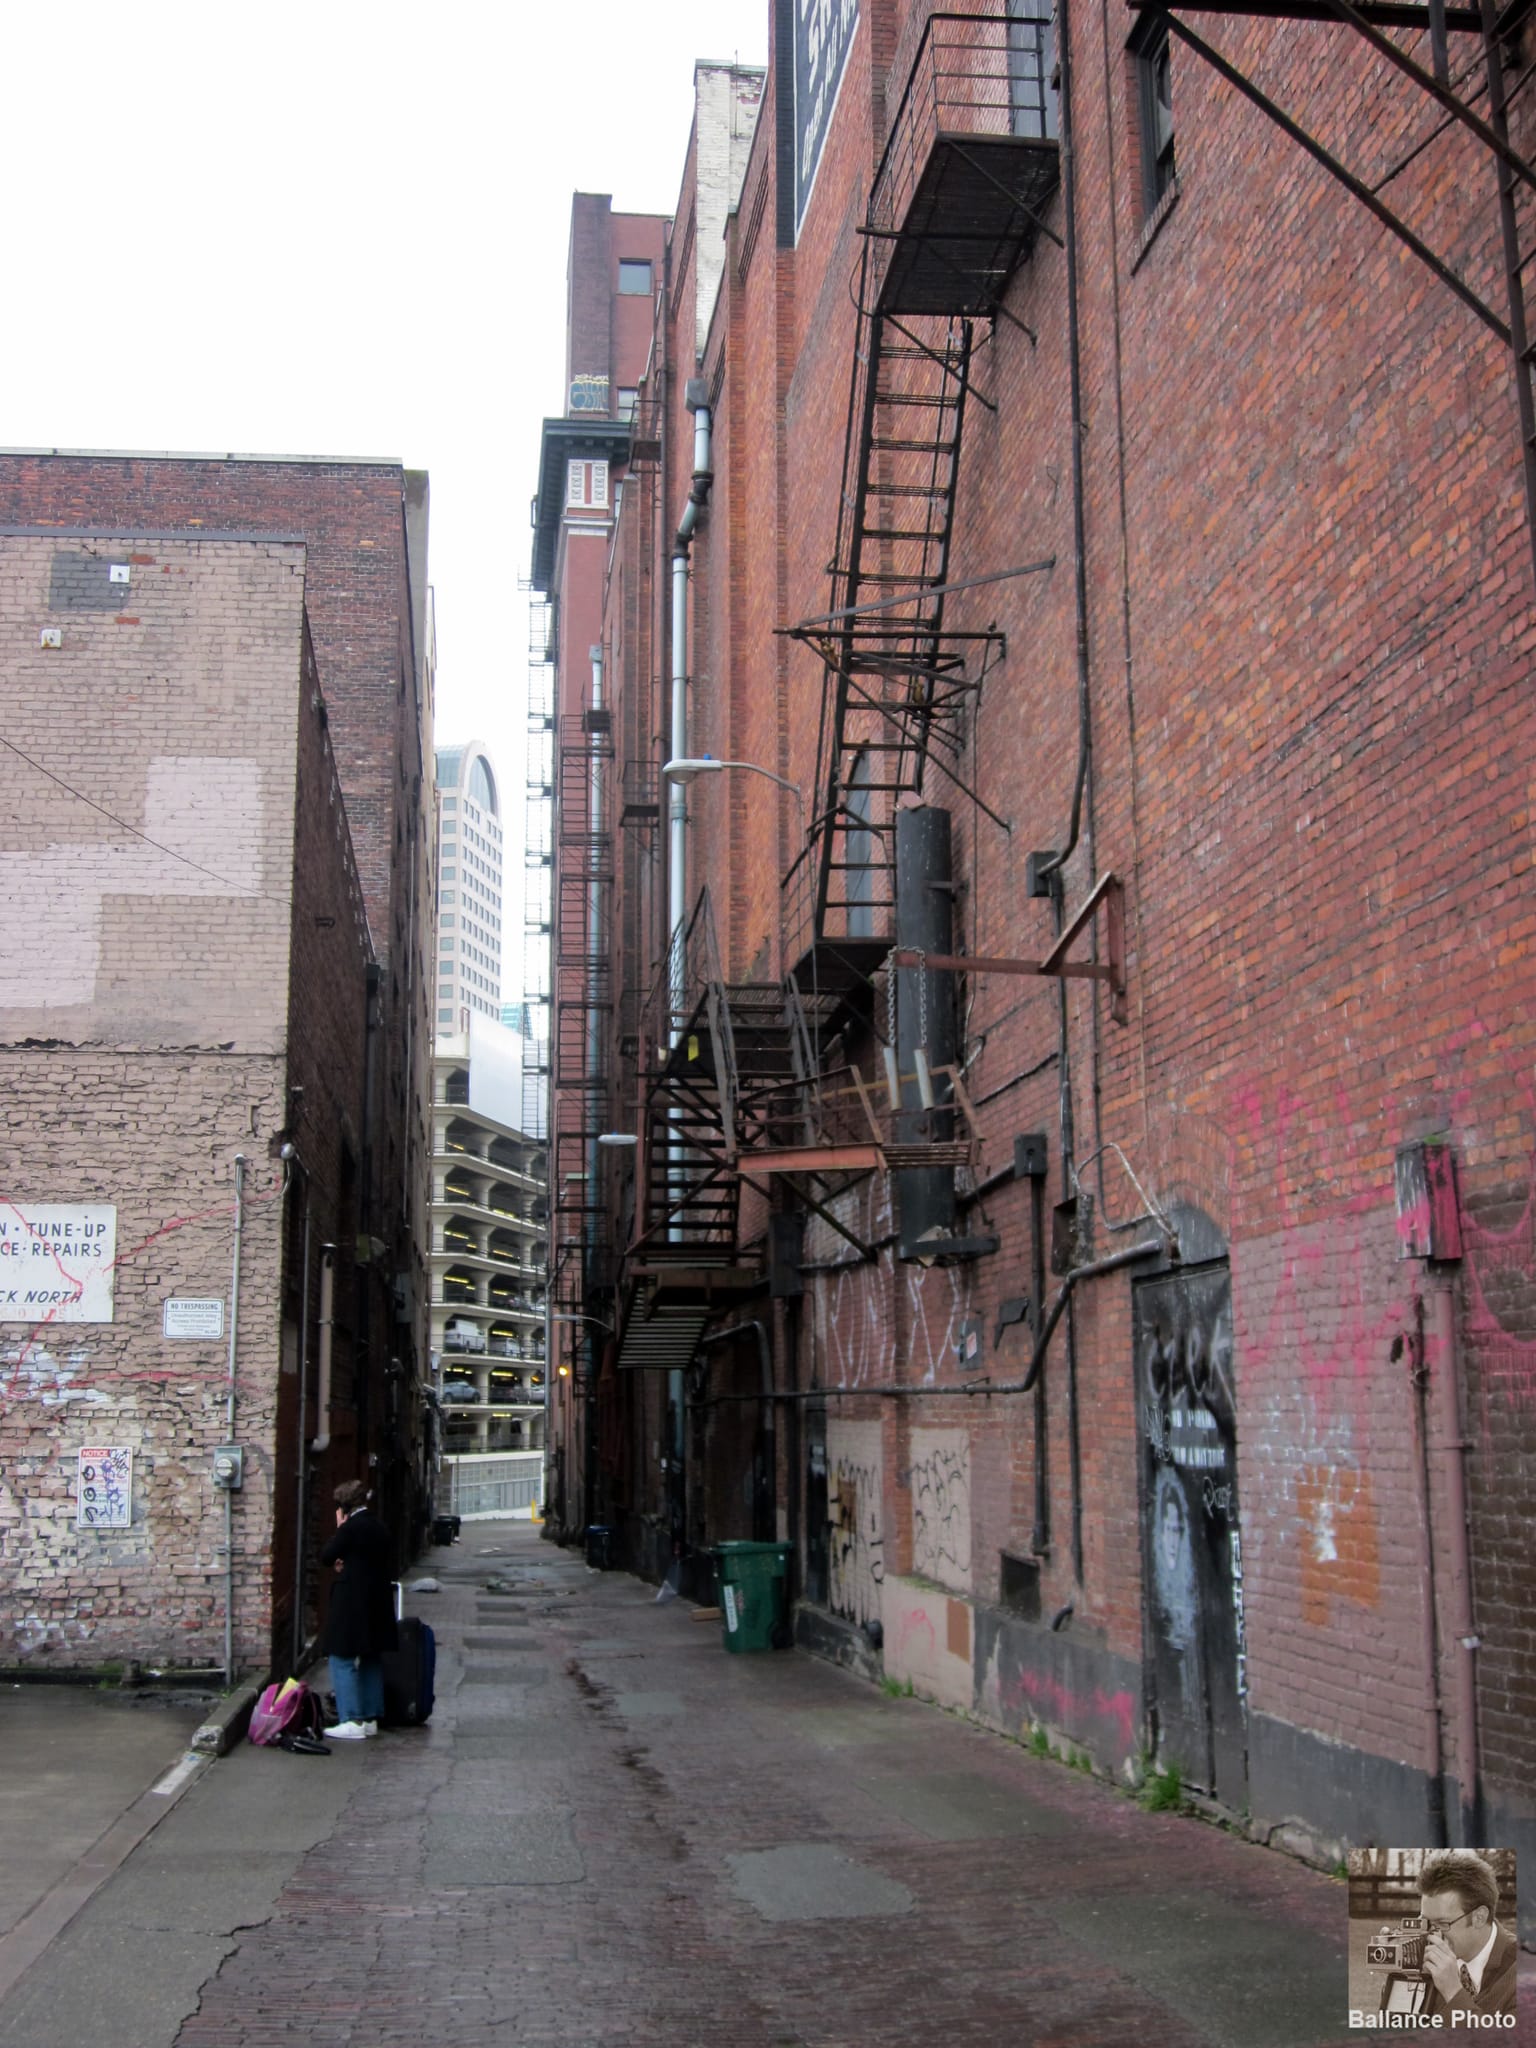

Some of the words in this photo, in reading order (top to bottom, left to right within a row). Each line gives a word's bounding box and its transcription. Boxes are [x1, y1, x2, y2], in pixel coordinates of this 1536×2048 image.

[26, 1223, 106, 1237] TUNE-UP
[32, 1243, 101, 1256] REPAIRS
[24, 1291, 82, 1303] NORTH
